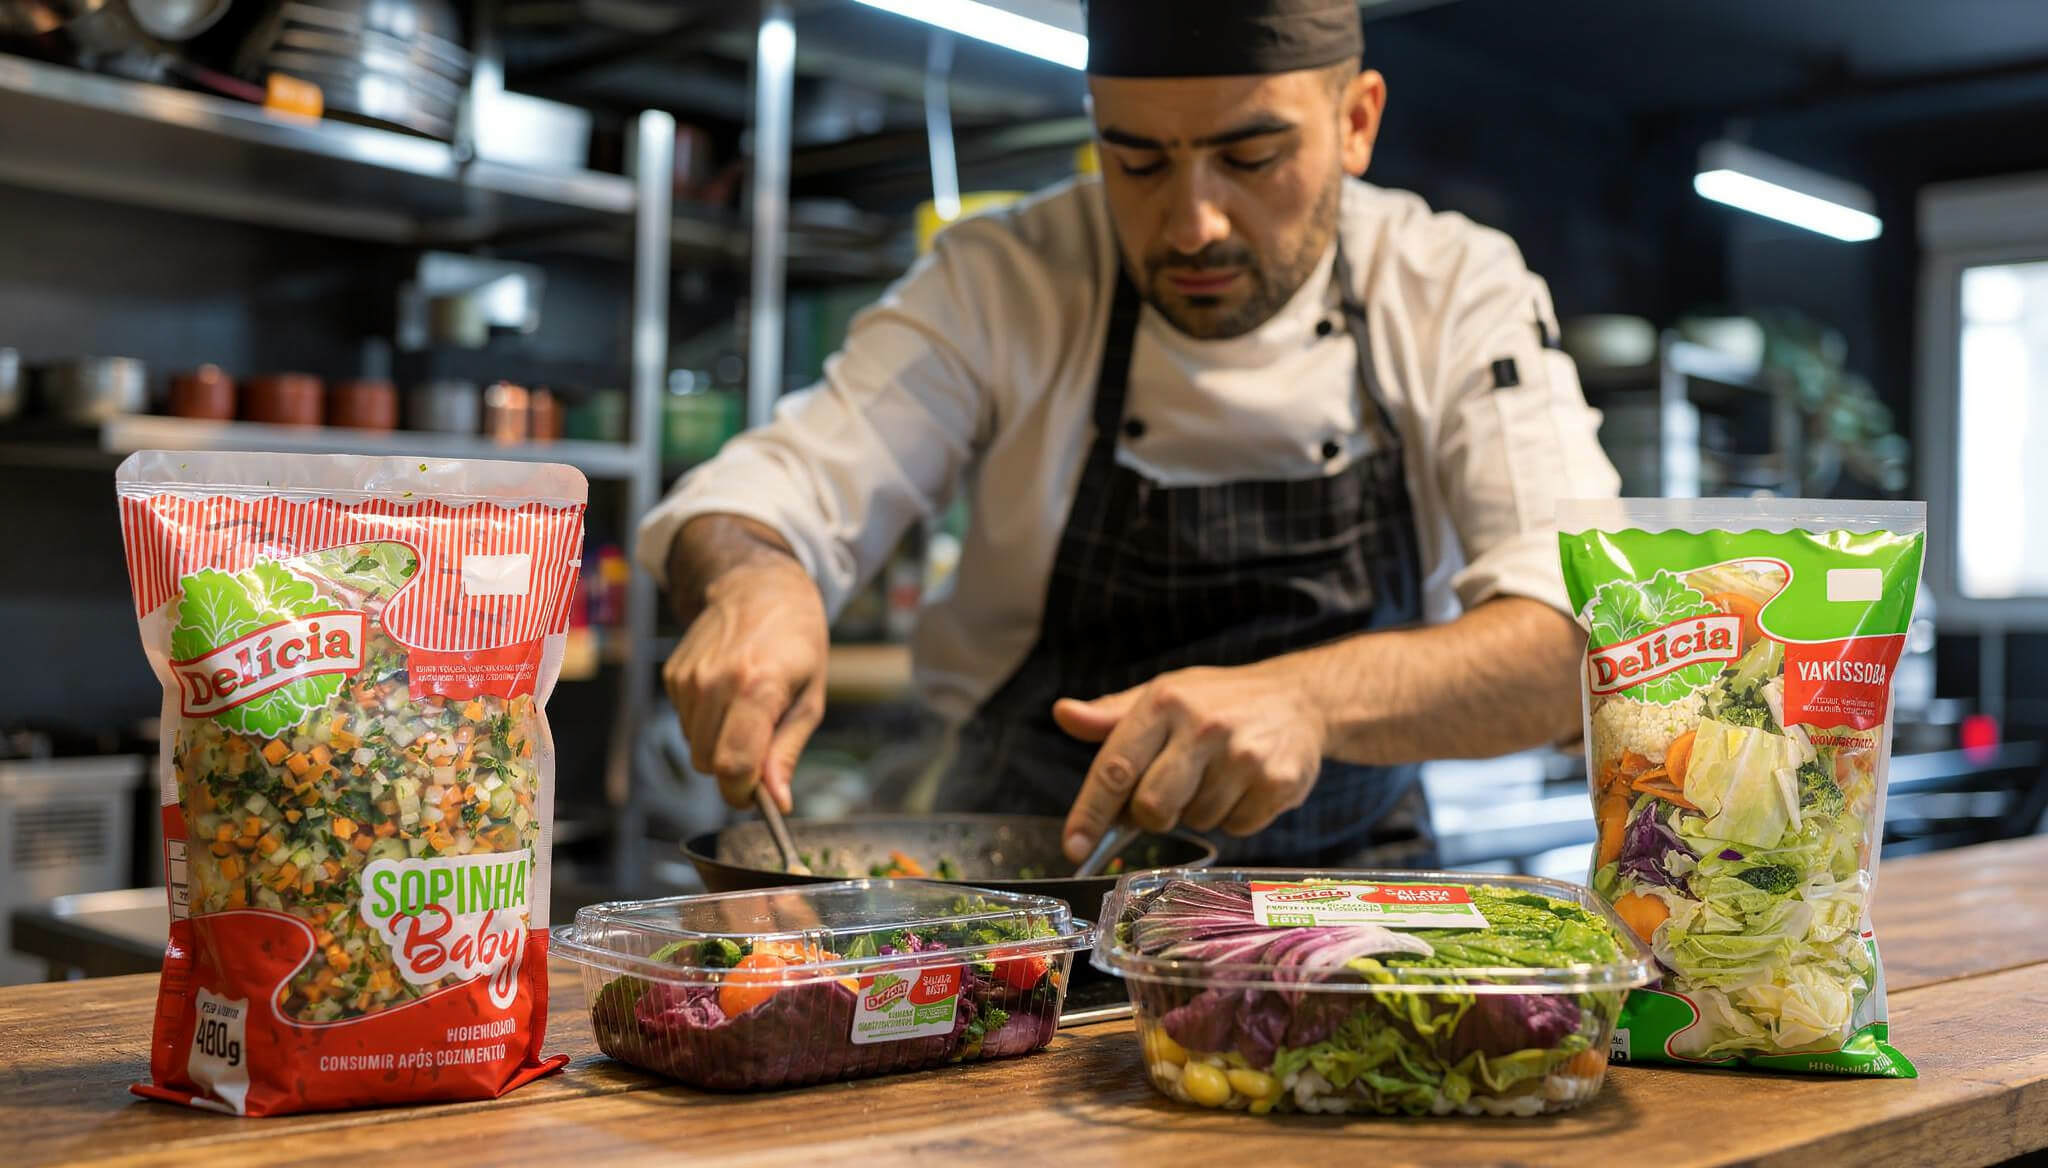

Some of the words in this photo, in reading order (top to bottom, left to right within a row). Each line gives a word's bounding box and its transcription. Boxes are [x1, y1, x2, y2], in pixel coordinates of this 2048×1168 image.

[182, 622, 354, 706] Delícia
[1592, 621, 1733, 686] Delícia
[1797, 660, 1886, 686] YAKISSOBA
[372, 859, 526, 919] SOPINHA
[388, 903, 520, 999] Baby
[196, 1018, 240, 1067] 480g
[320, 1053, 394, 1072] CONSUMIR
[398, 1047, 433, 1069] APÓS
